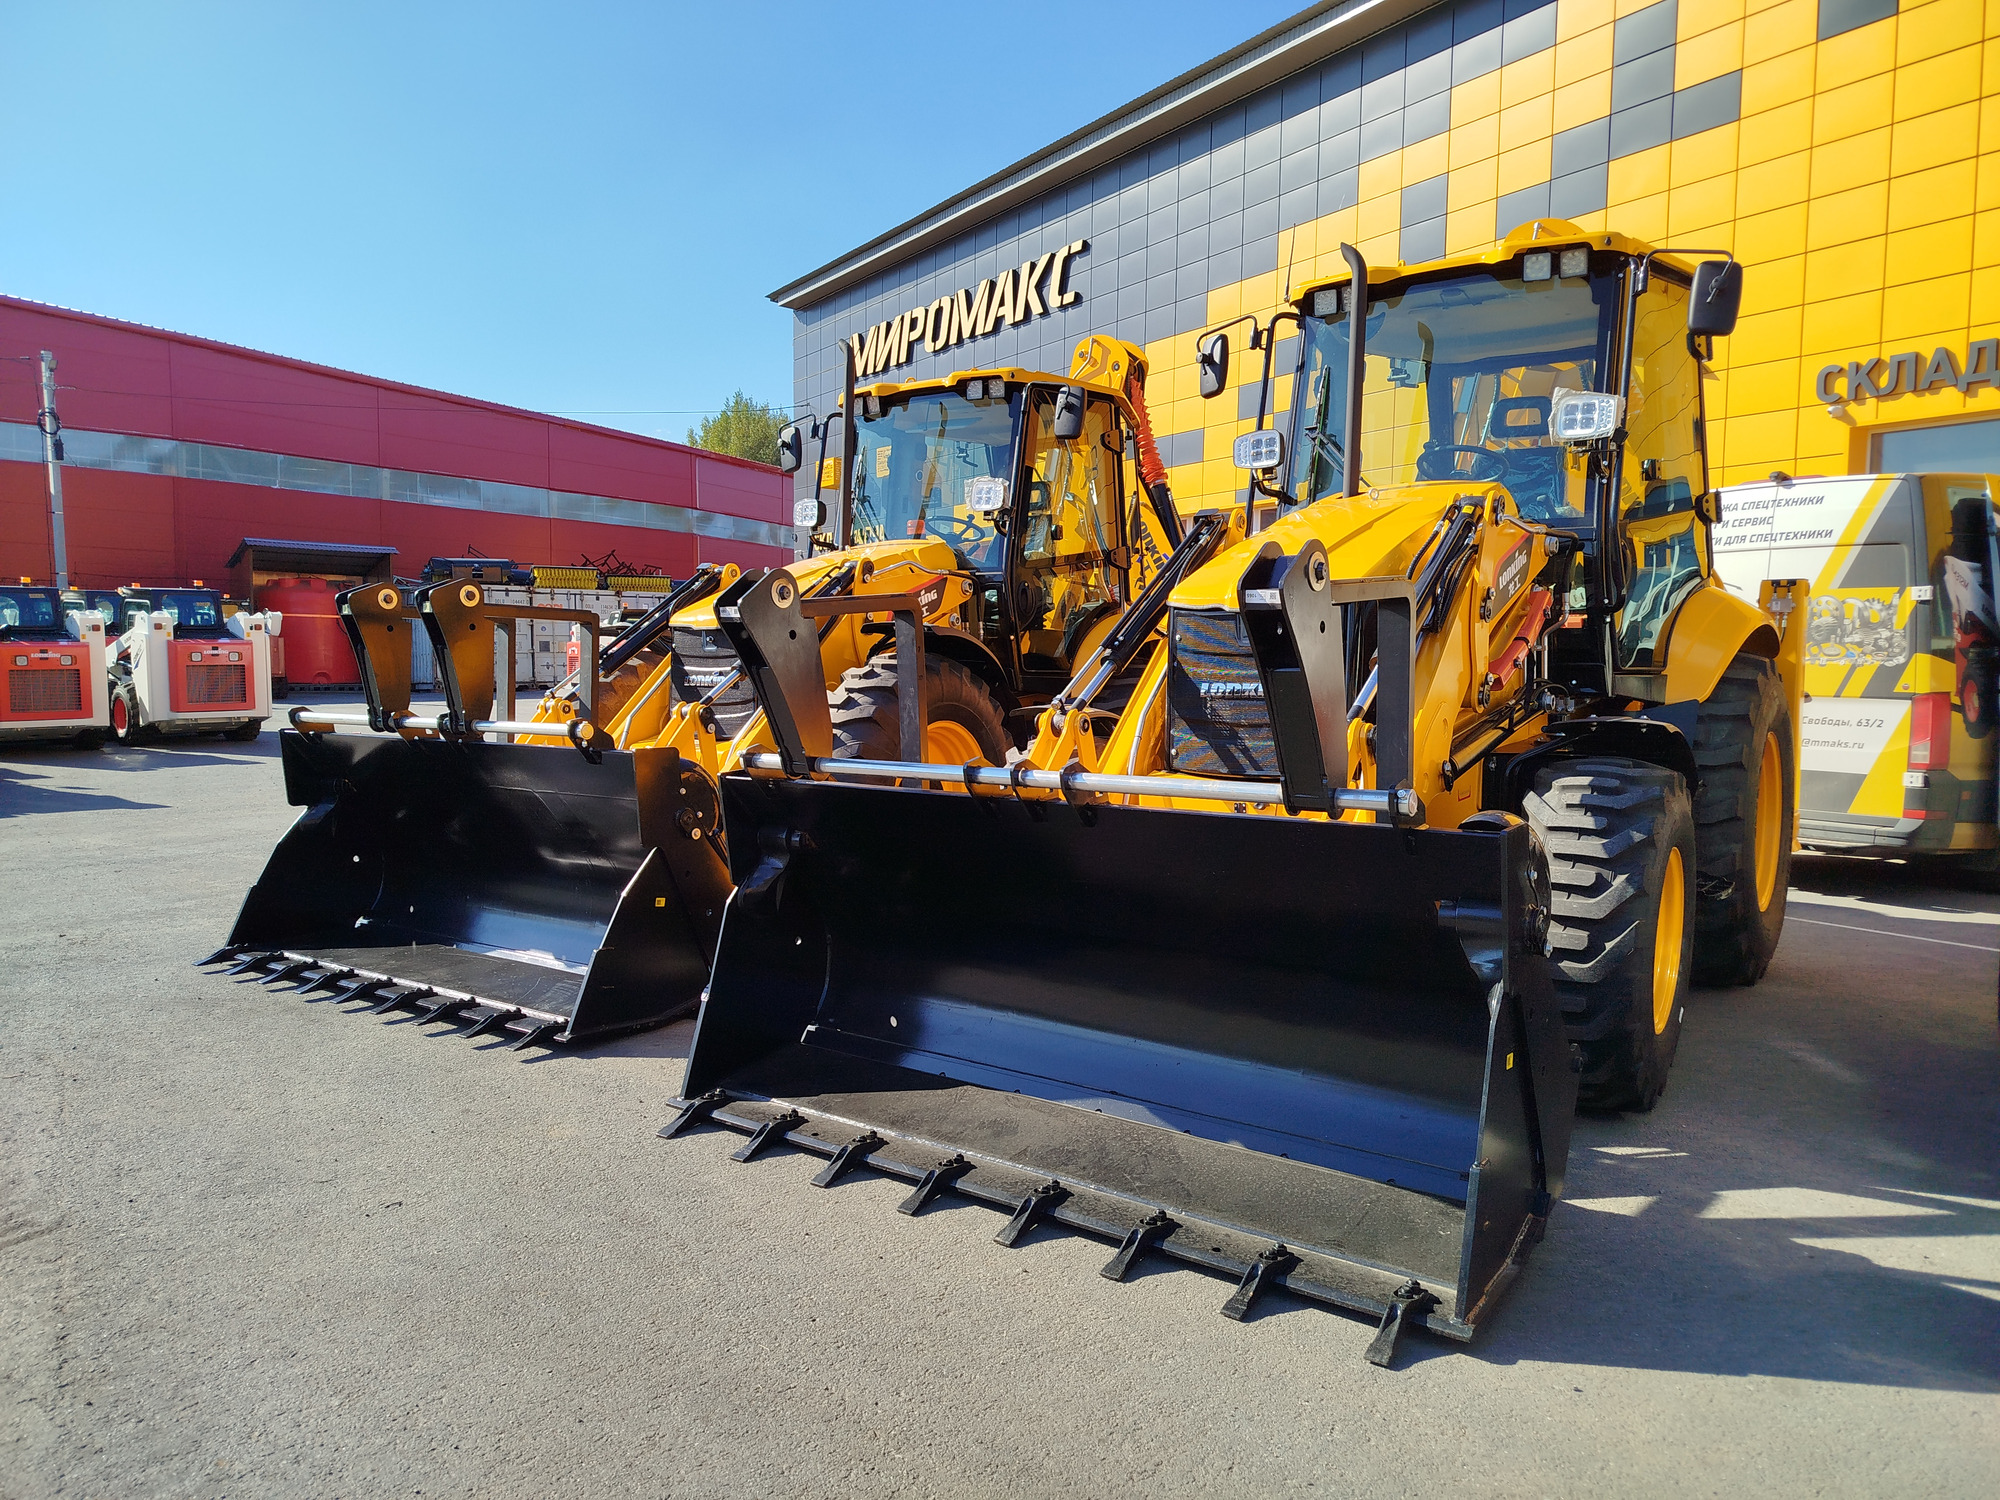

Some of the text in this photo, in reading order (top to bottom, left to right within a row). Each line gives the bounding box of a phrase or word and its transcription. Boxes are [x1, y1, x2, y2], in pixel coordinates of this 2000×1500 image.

[1816, 338, 2000, 403] СКЛАД
[1721, 496, 1825, 512] ЖА СПЕЦТЕХНИКИ
[1731, 516, 1774, 528] СЕРВИС
[1723, 535, 1747, 546] ДЛЯ
[1749, 529, 1834, 543] СПЕЦТЕХНИКИ
[1856, 719, 1884, 728] 63/2
